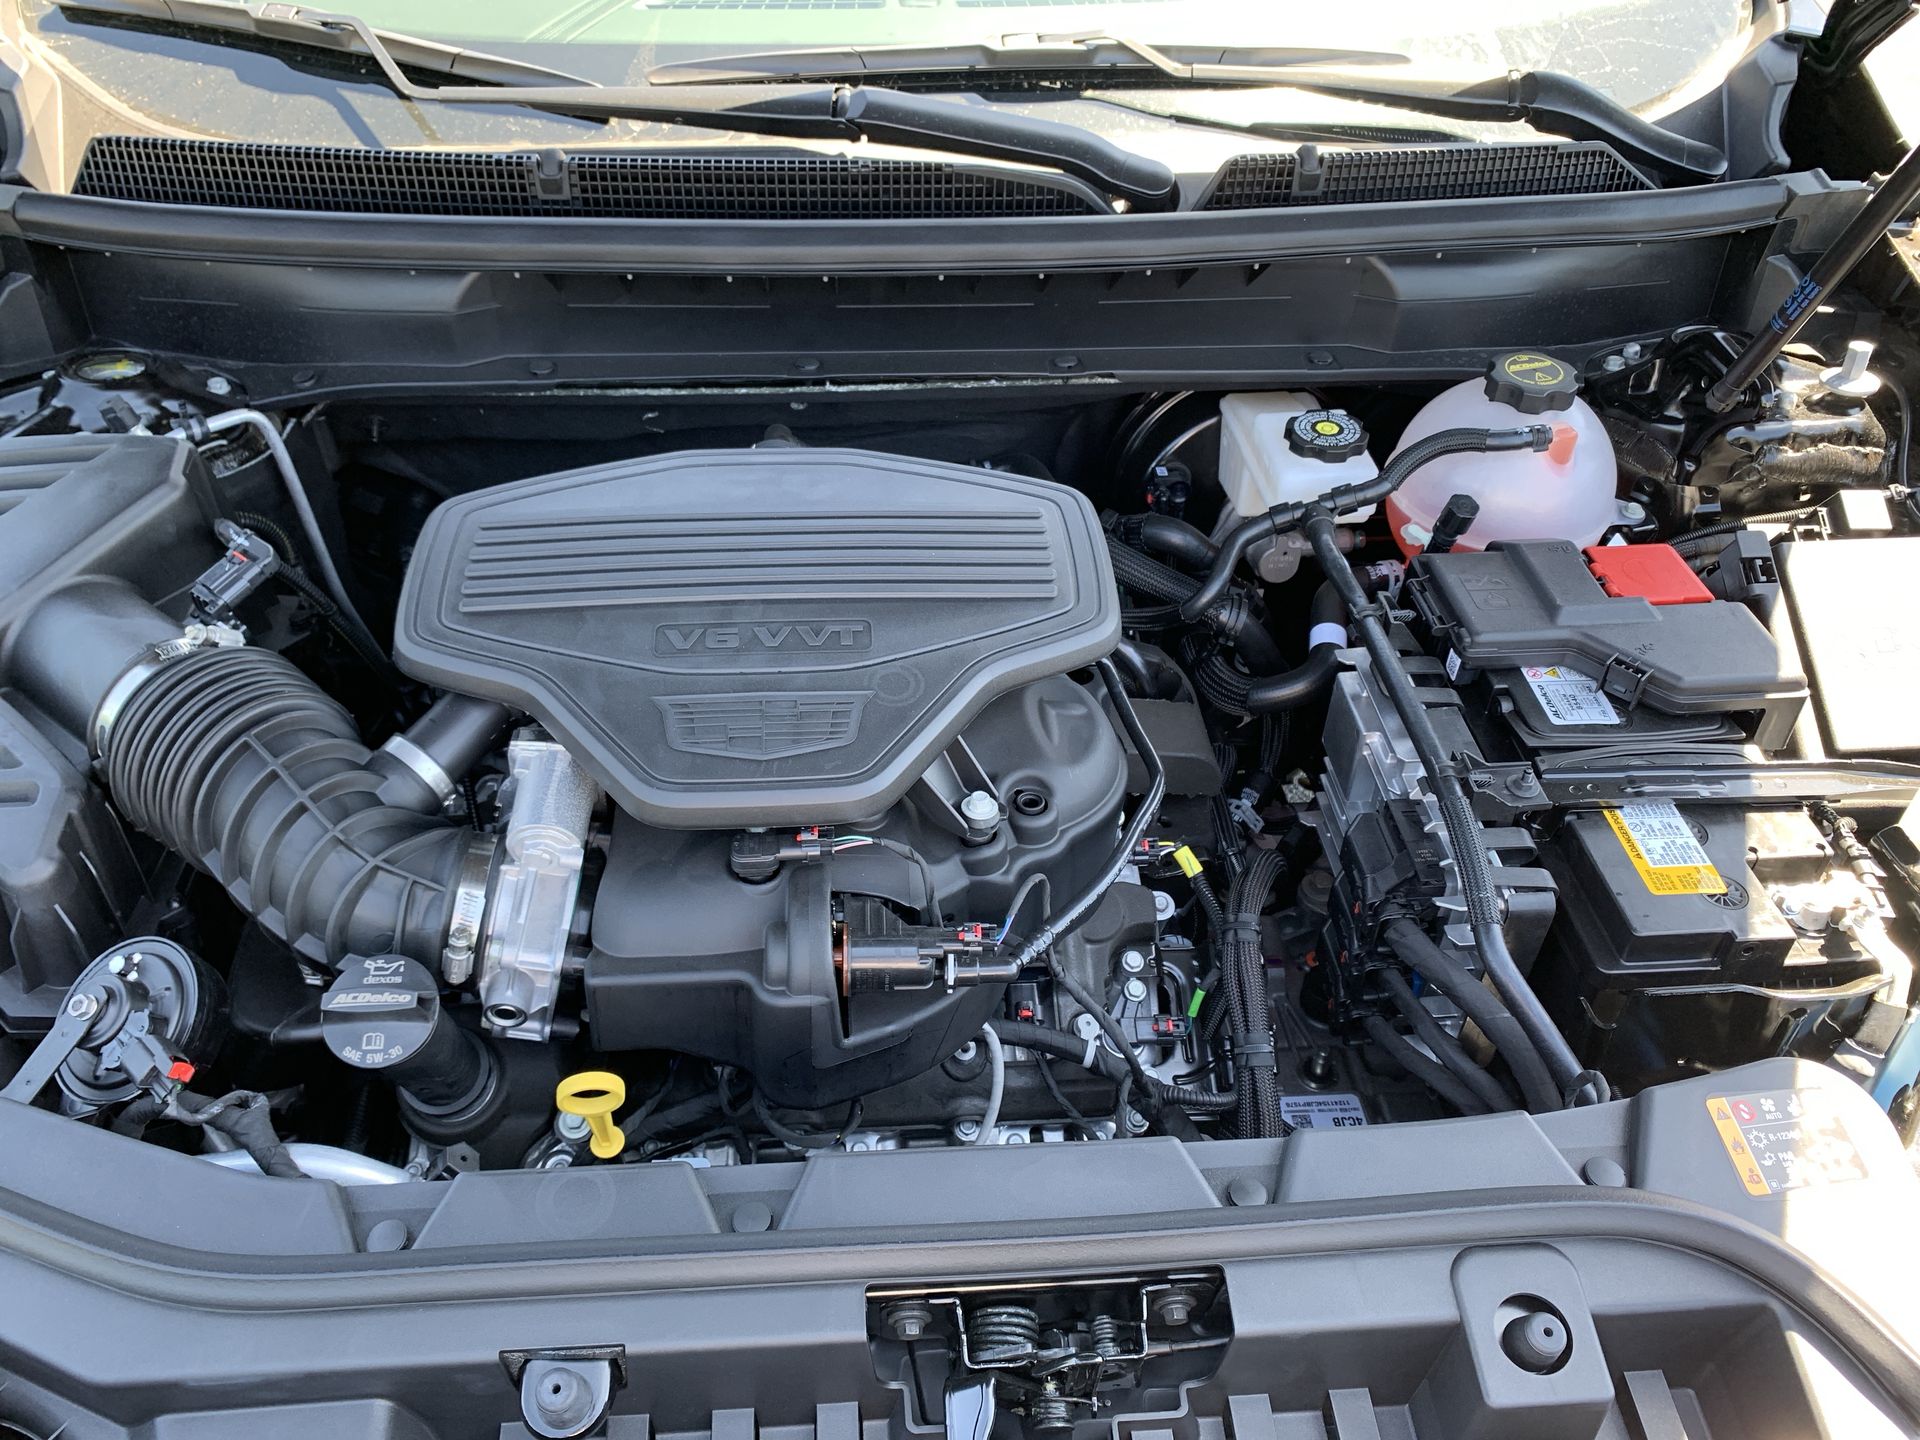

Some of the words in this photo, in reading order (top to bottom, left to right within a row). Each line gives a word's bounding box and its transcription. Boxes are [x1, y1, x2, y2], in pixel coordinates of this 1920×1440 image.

[663, 627, 740, 650] V6
[752, 625, 864, 647] VVT
[1537, 684, 1563, 720] ACDelco
[1617, 826, 1638, 853] DANGER
[363, 975, 403, 984] dexos
[331, 992, 412, 1004] ACDelco
[342, 1046, 363, 1062] SAE
[366, 1045, 403, 1064] 5W-30
[1332, 1116, 1363, 1127] 4CJB
[1765, 1111, 1783, 1121] AUTO
